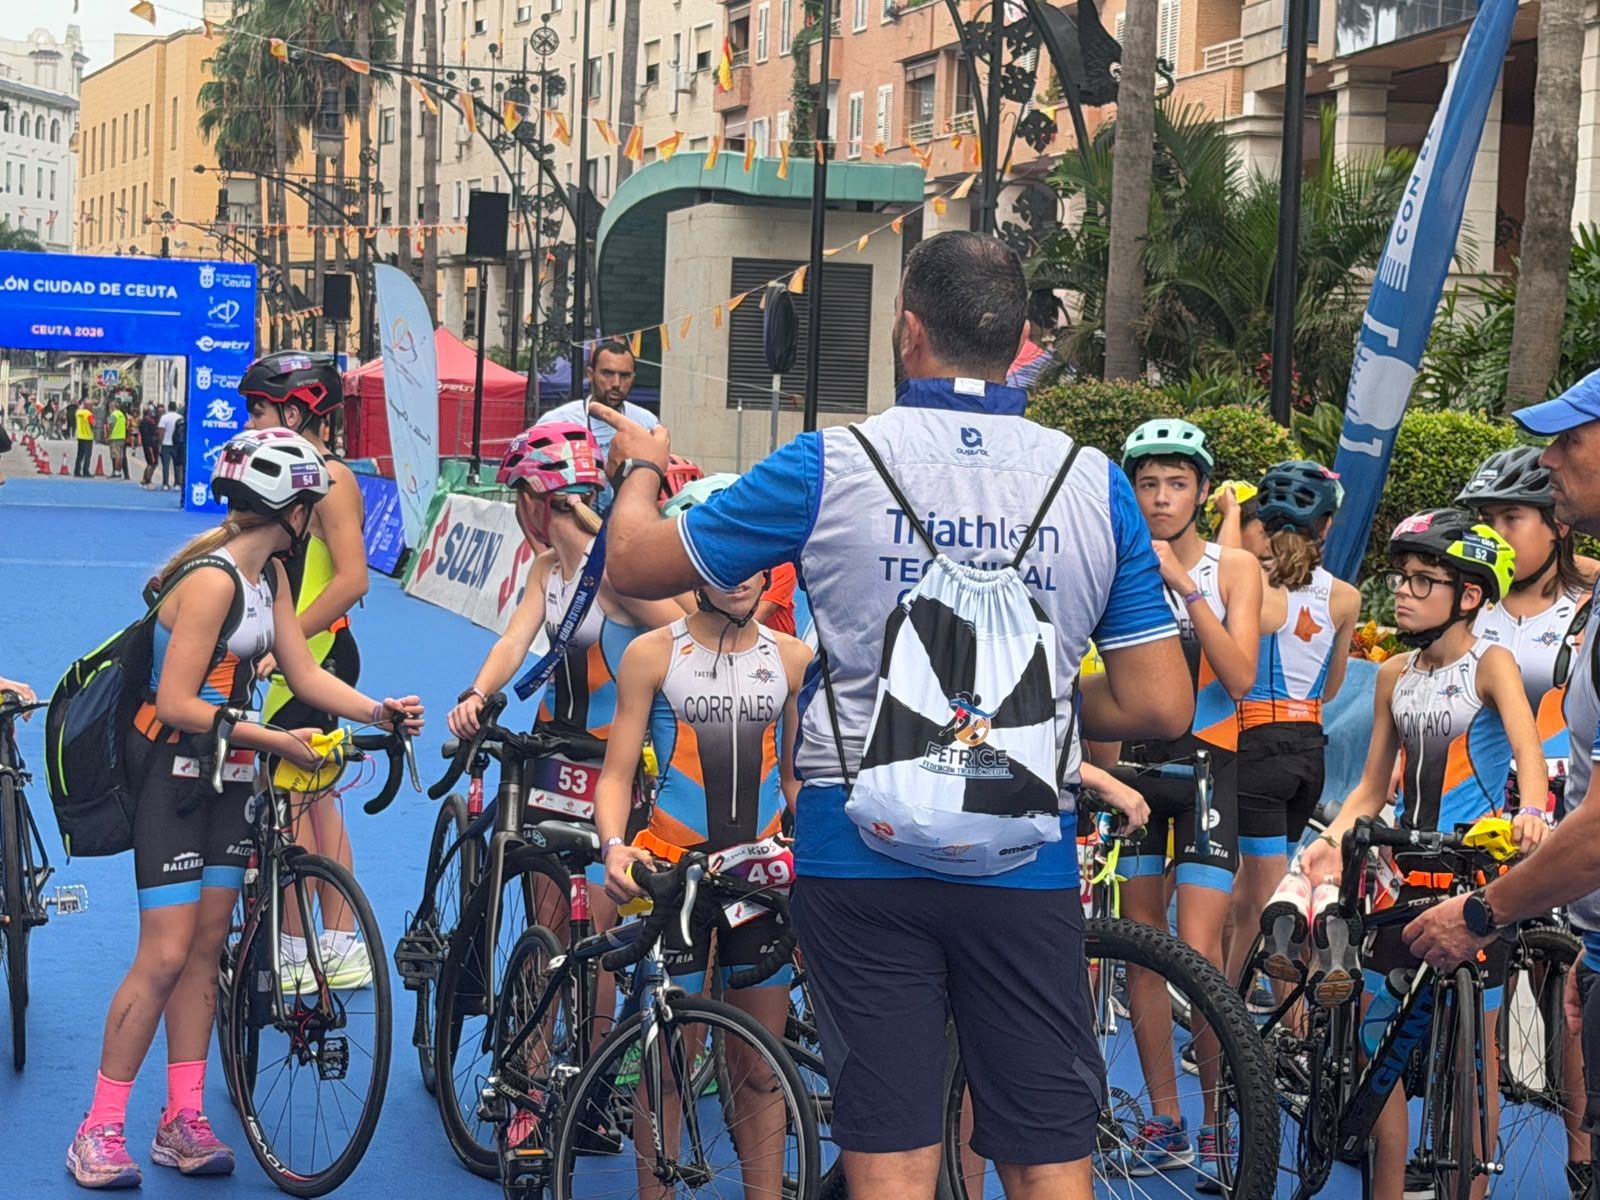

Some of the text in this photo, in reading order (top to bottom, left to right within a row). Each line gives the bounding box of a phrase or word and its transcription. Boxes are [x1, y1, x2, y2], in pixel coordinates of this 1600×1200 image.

[1396, 174, 1421, 246] CON
[33, 279, 95, 295] CIUDAD
[99, 282, 121, 297] DE
[125, 285, 178, 299] CEUTA
[222, 279, 251, 288] Ceuta
[32, 325, 71, 336] CEUTA
[302, 475, 314, 486] 54
[1474, 548, 1487, 560] 52
[684, 694, 775, 724] CORRALES
[925, 741, 1010, 767] FETRICE
[558, 765, 588, 794] 53
[747, 860, 790, 885] 49
[1369, 983, 1433, 1095] GIANT
